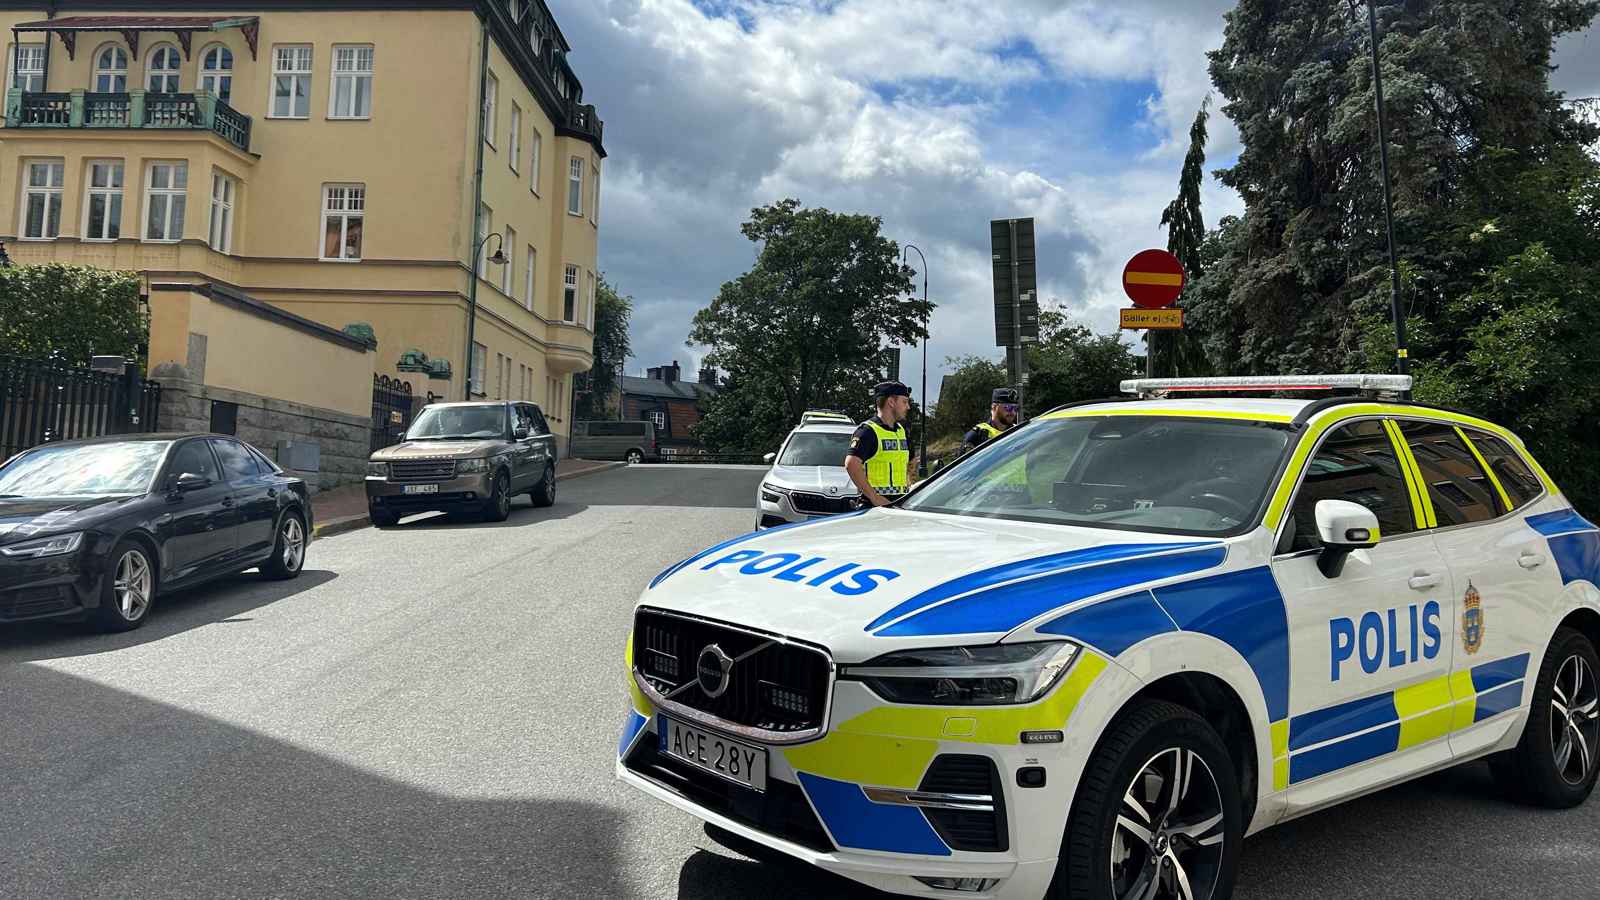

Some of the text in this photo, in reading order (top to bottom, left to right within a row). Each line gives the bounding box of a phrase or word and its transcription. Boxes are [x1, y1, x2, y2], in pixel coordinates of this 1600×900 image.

[700, 550, 901, 596] POLIS
[1330, 600, 1442, 682] POLIS
[673, 726, 756, 781] ACE 28Y
